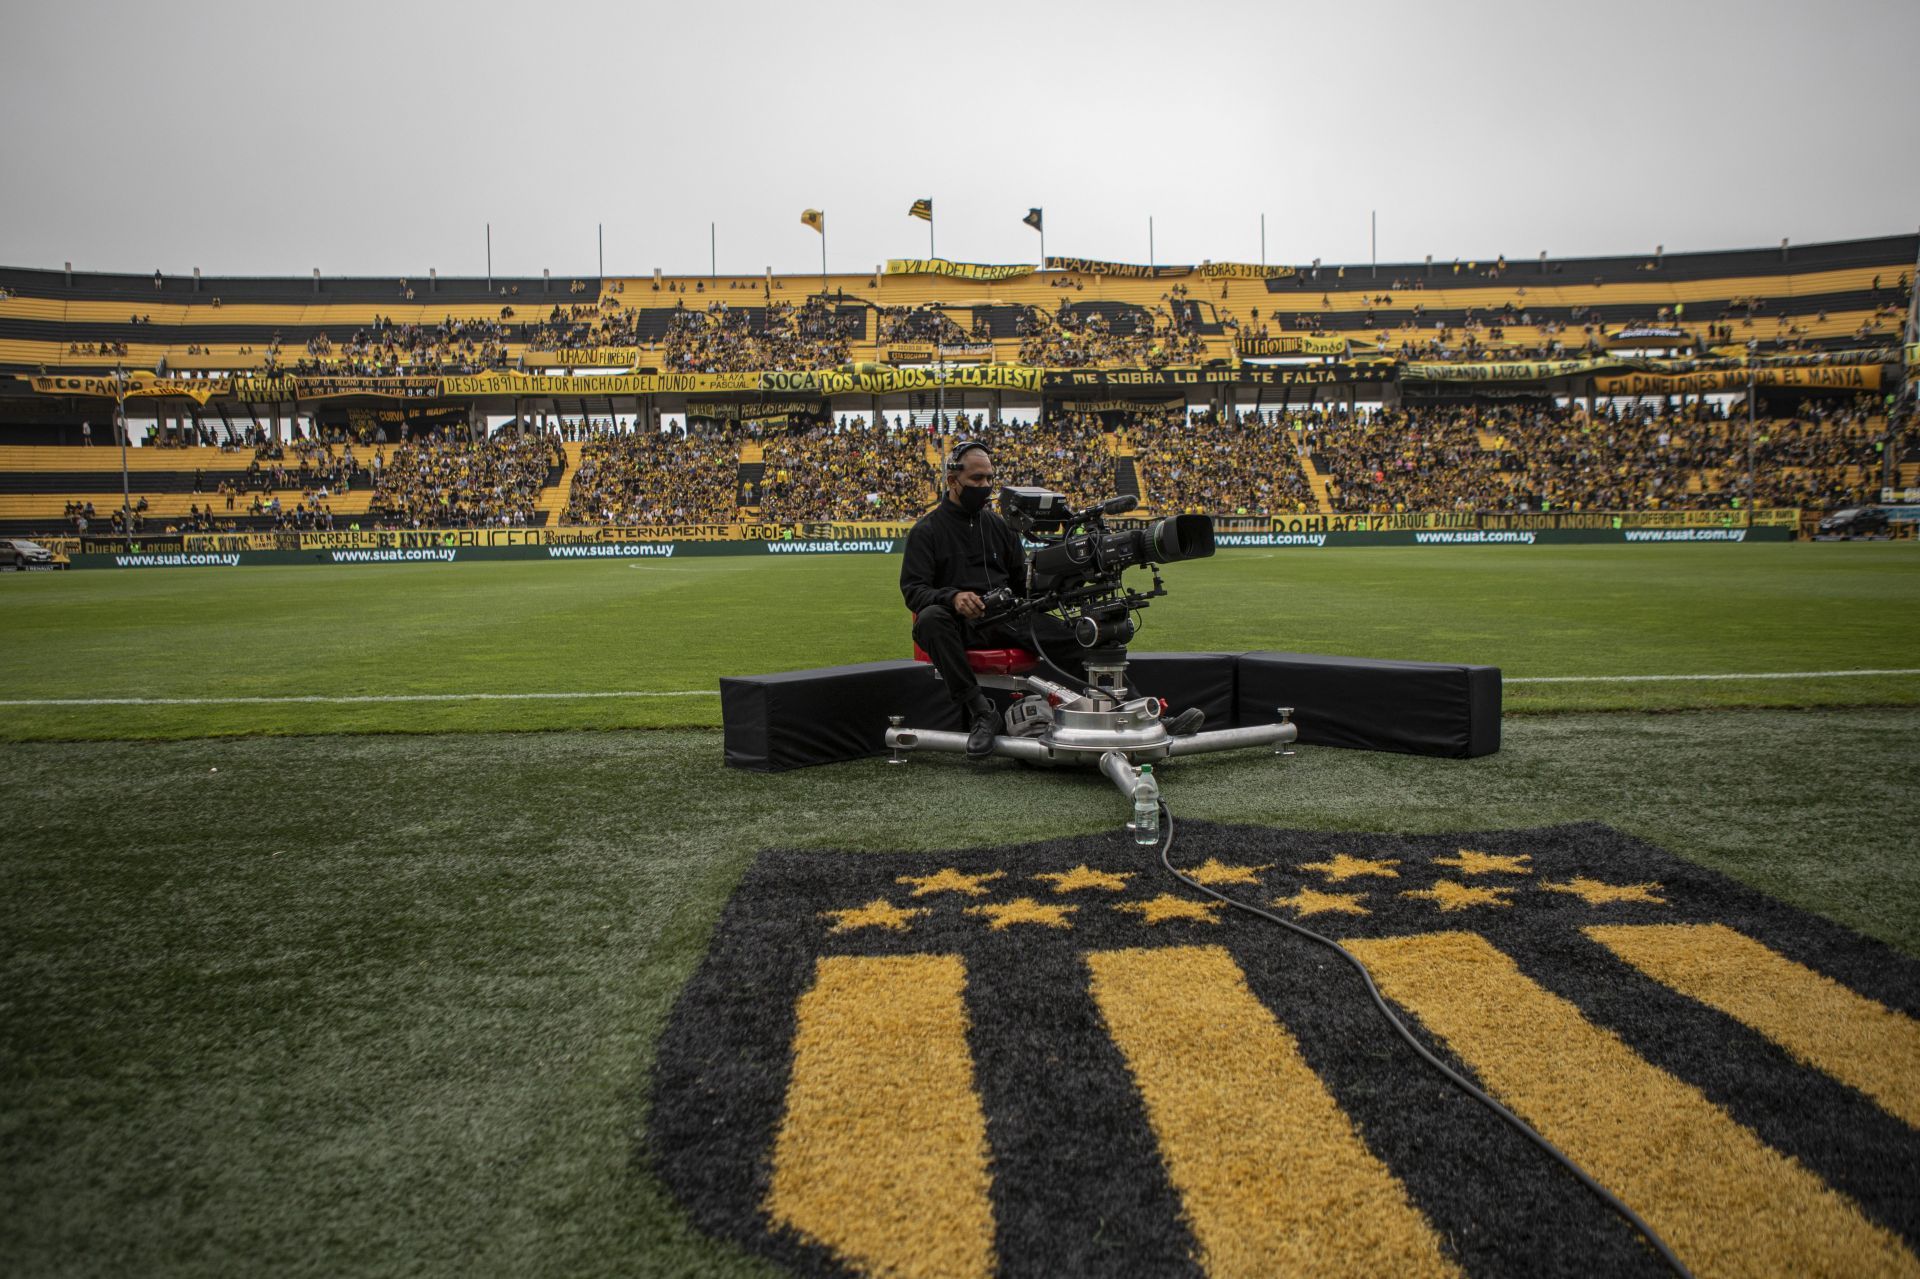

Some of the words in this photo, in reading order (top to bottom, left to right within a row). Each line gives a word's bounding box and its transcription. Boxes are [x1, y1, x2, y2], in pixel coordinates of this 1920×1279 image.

[904, 259, 945, 274] VILLA
[945, 262, 965, 277] DEL
[1109, 264, 1154, 278] MANYA
[1199, 264, 1236, 277] PIEDRAS
[556, 349, 597, 364] DURAZNO
[447, 377, 486, 393] DESDE
[488, 376, 512, 392] 1891
[514, 377, 530, 392] LA
[532, 375, 569, 392] MEJOR
[573, 376, 629, 392] HINCHADA
[632, 375, 655, 391] DEL
[658, 375, 696, 391] MUNDO
[762, 372, 816, 390] SOCA
[821, 372, 854, 394] LOS
[932, 368, 955, 385] DE
[961, 368, 982, 385] LA
[986, 367, 1042, 392] FIESTA
[1073, 373, 1098, 384] ME
[1105, 372, 1164, 384] SOBRA
[1174, 372, 1197, 384] LO
[1205, 372, 1241, 383] QUE
[1251, 372, 1274, 383] TE
[1282, 371, 1336, 384] FALTA
[1629, 373, 1718, 395] CANELONES
[1782, 369, 1802, 384] EL
[1808, 367, 1863, 386] MANYA
[153, 380, 229, 393] SIEMPRE
[710, 381, 749, 389] PASCUAL
[1388, 515, 1428, 529] PARQUE
[1560, 514, 1613, 529] ANORMA
[302, 533, 377, 545] INCREIBLE
[602, 525, 729, 539] ETERNAMENTE
[740, 524, 802, 540] VERDISL
[1416, 531, 1536, 544] www.suat.com.uy
[1625, 529, 1747, 542] www.suat.com.uy
[549, 543, 674, 557] www.suat.com.uy
[768, 540, 893, 553] www.suat.com.uy
[116, 553, 240, 567] www.suat.com.uy
[332, 548, 456, 562] www.suat.com.uy
